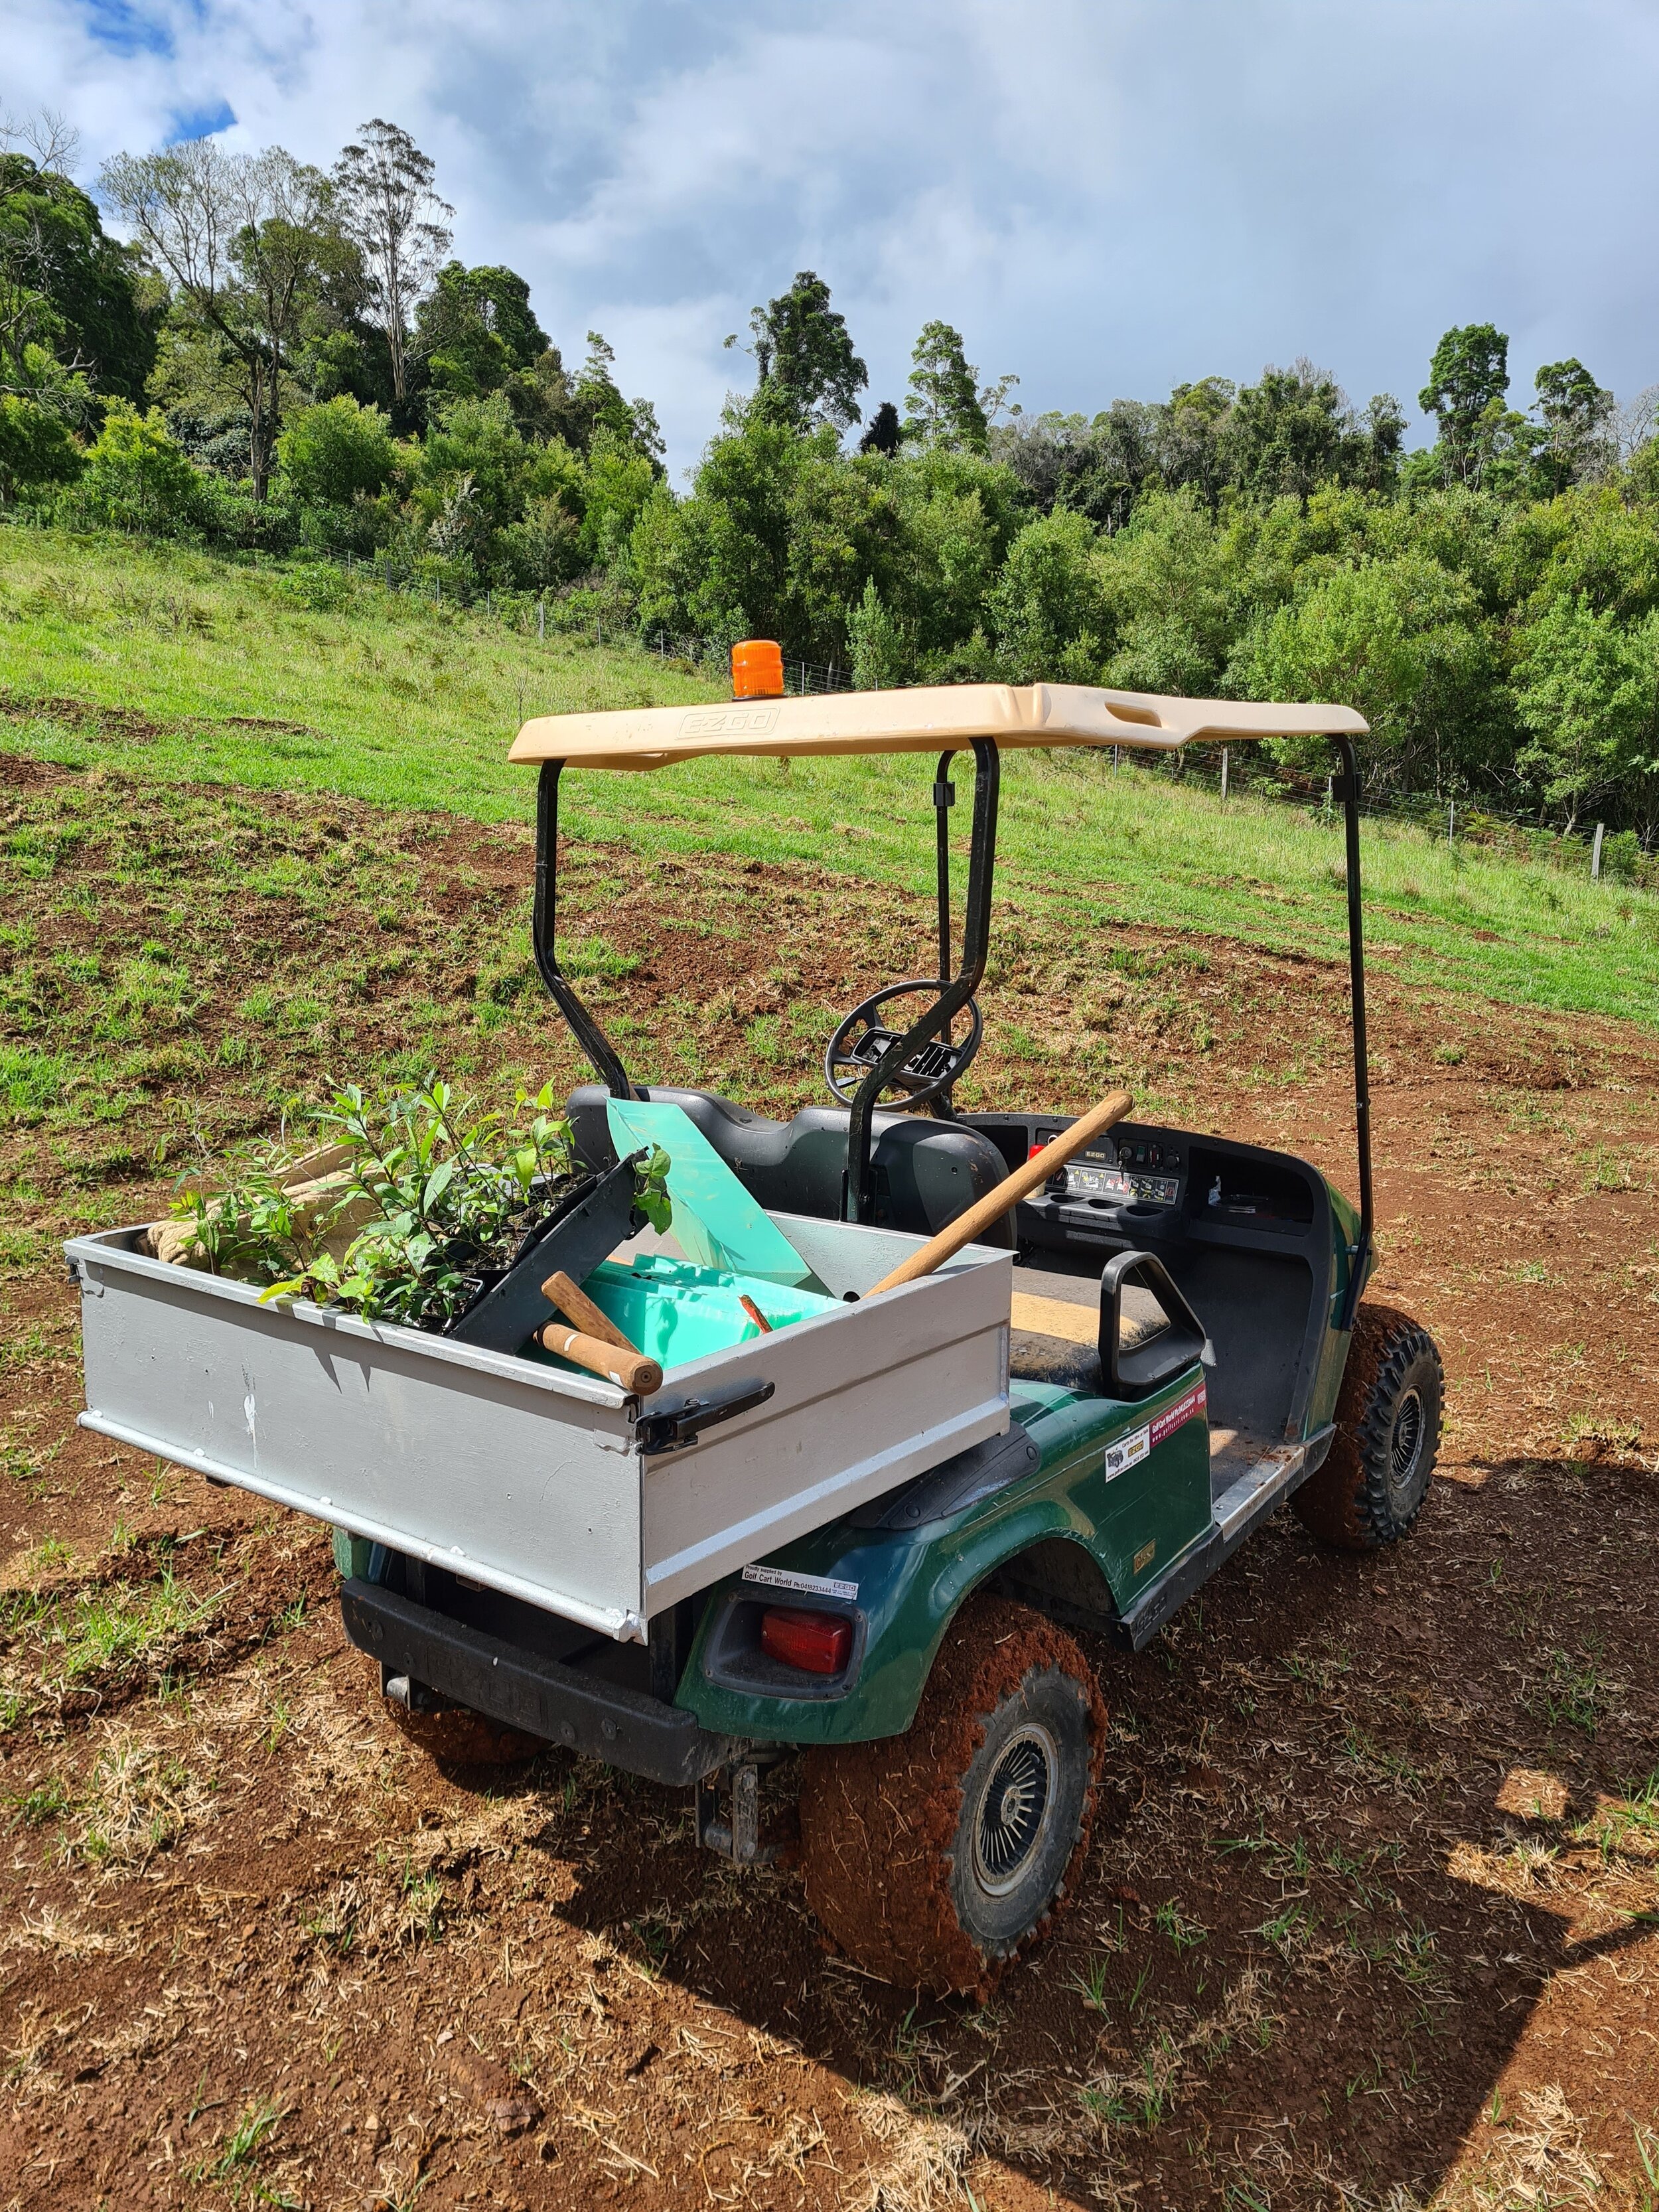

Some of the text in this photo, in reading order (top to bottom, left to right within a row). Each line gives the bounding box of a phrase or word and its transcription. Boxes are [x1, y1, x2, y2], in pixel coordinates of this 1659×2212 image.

[745, 1572, 758, 1580] Golf
[759, 1574, 772, 1583] Cart
[774, 1577, 792, 1587] World
